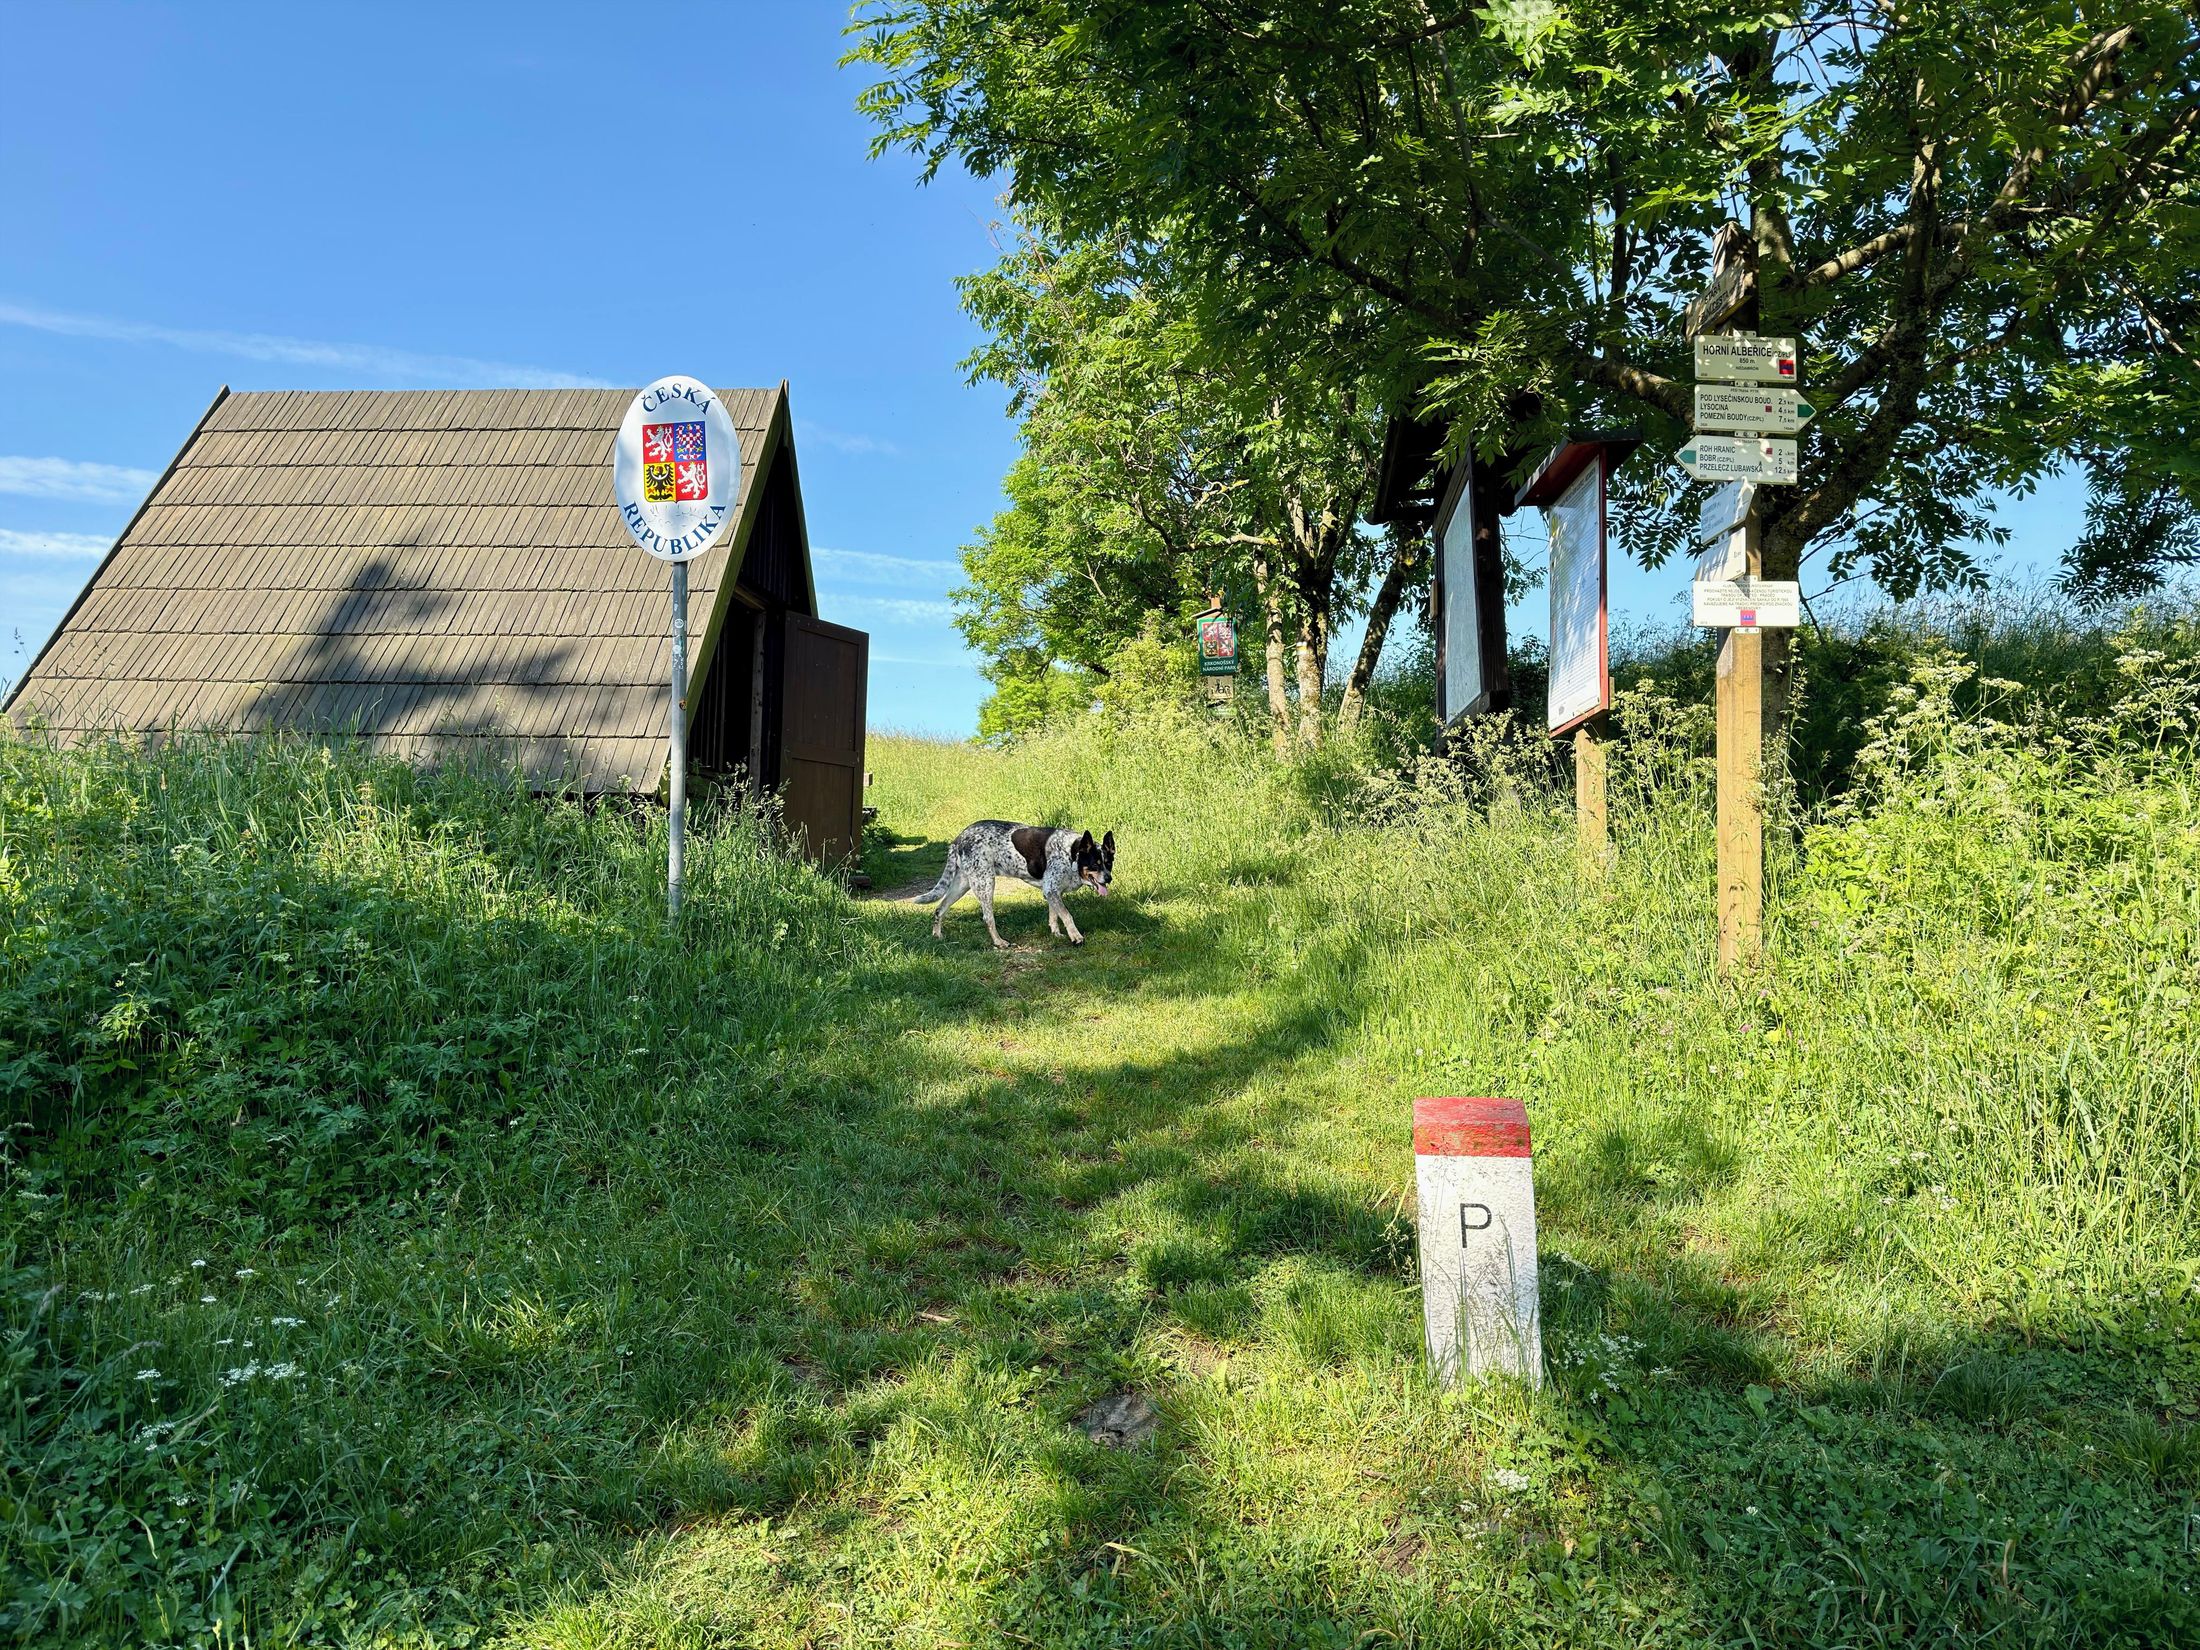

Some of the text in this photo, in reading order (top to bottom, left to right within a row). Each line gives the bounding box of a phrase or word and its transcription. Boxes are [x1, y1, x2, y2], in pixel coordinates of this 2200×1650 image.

[1703, 344, 1729, 356] HORNÍ
[1731, 345, 1772, 357] ALBEŘICE
[642, 383, 716, 415] ČESKÁ
[1714, 394, 1753, 403] LYSEČINSKOU
[1700, 412, 1726, 420] POMEZNÍ
[623, 501, 727, 556] REPUBLIKA
[1459, 1202, 1493, 1249] P
